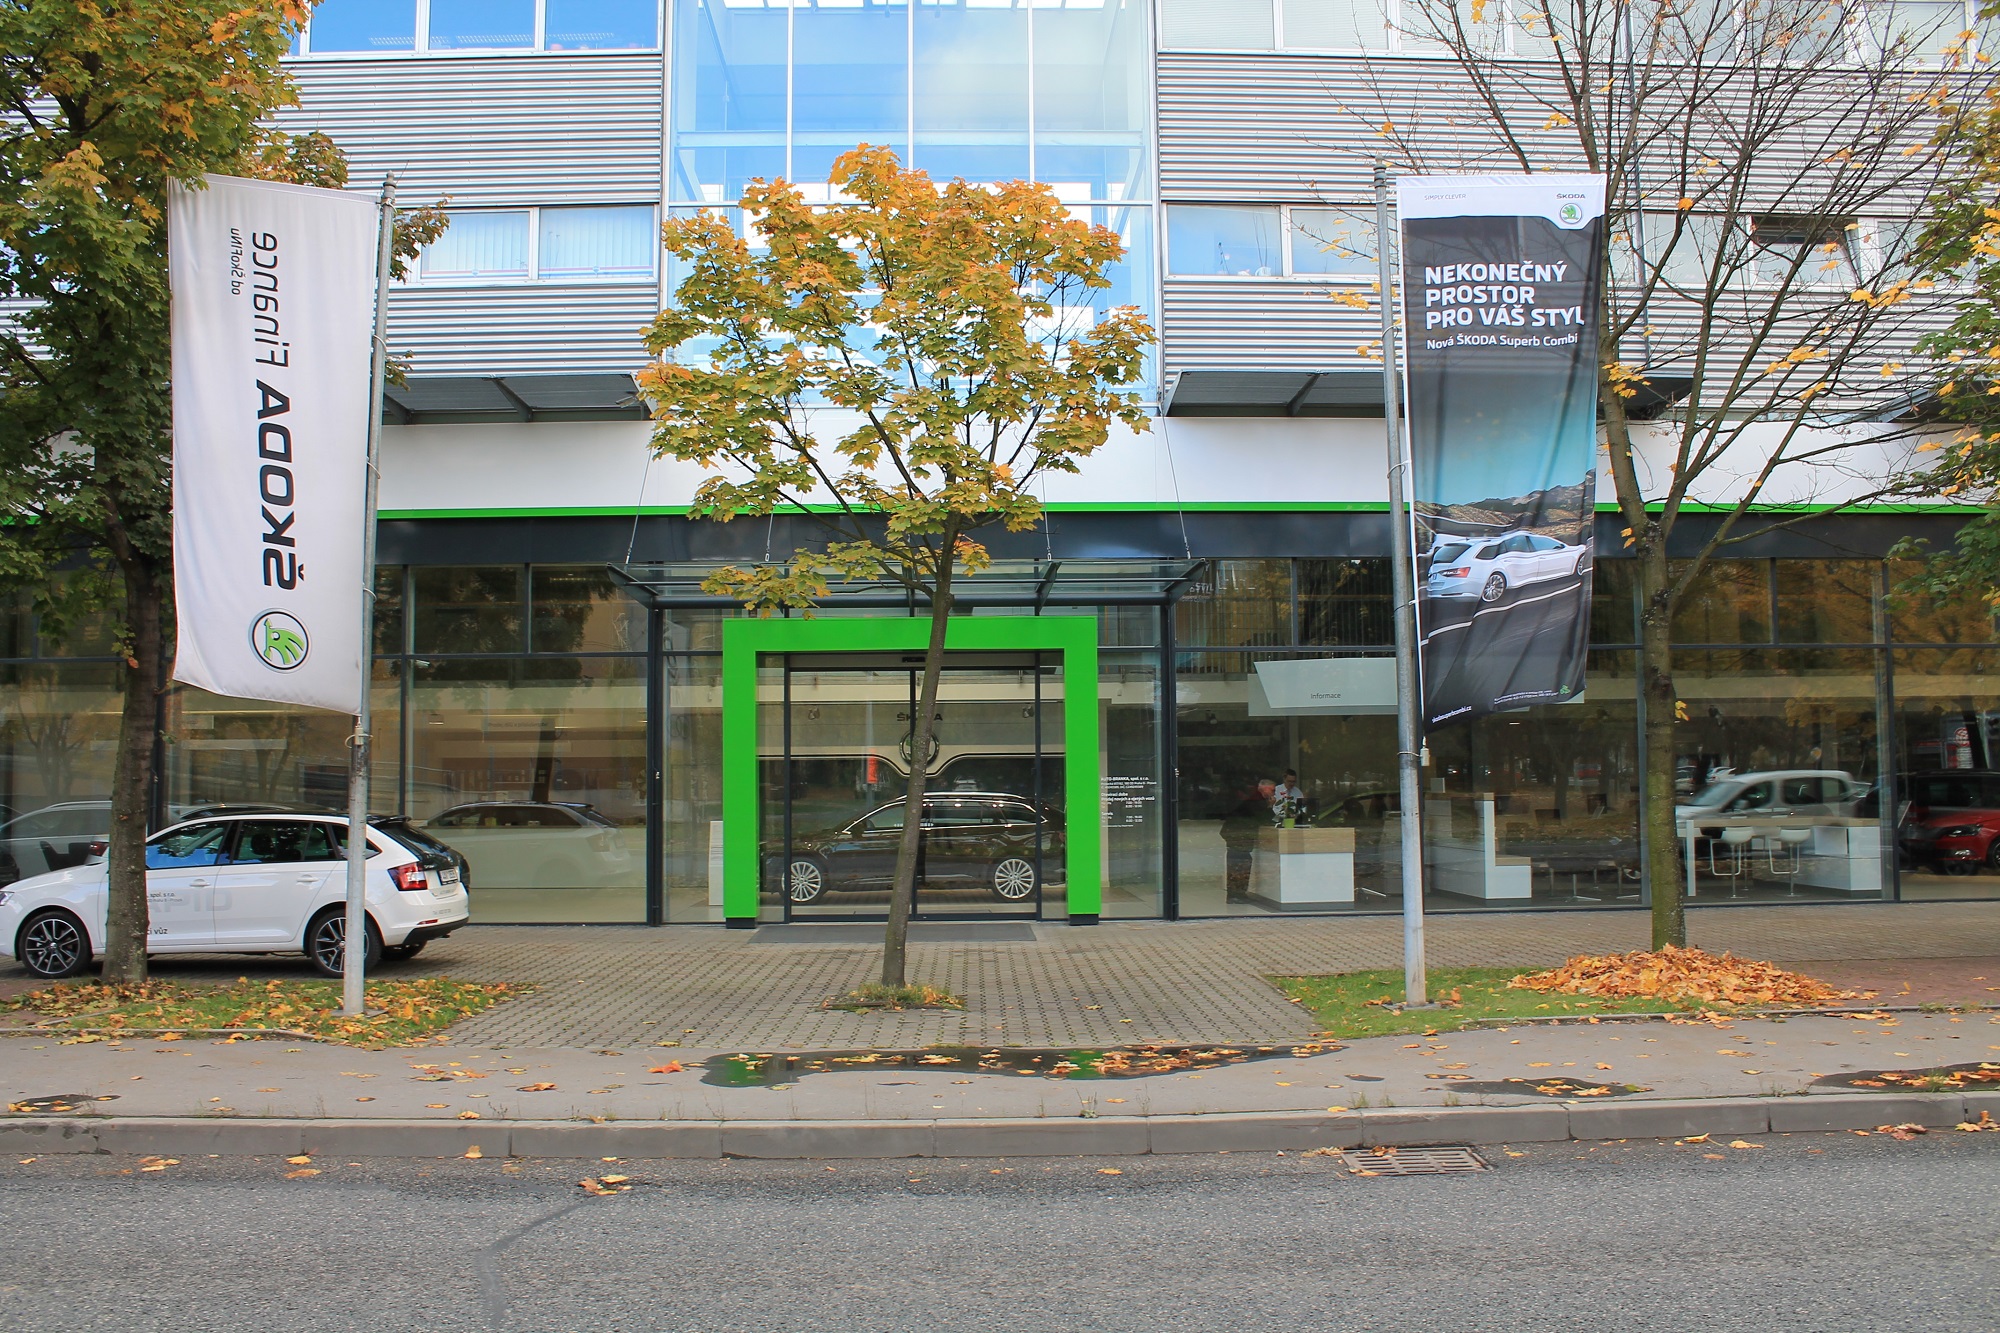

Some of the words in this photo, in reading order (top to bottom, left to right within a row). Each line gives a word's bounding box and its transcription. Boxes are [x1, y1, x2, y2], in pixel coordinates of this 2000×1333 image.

[1424, 260, 1568, 285] NEKONEČNÝ
[1425, 285, 1535, 308] PROSTOR
[1425, 307, 1473, 330] PRO
[1478, 304, 1526, 327] VÁŠ
[1531, 305, 1585, 327] STYL
[1426, 336, 1454, 350] Nová
[1456, 333, 1497, 346] ŠKODA
[1499, 334, 1540, 349] Superb
[1543, 332, 1578, 347] Combi
[1310, 692, 1342, 700] Informace
[153, 927, 168, 935] vůz
